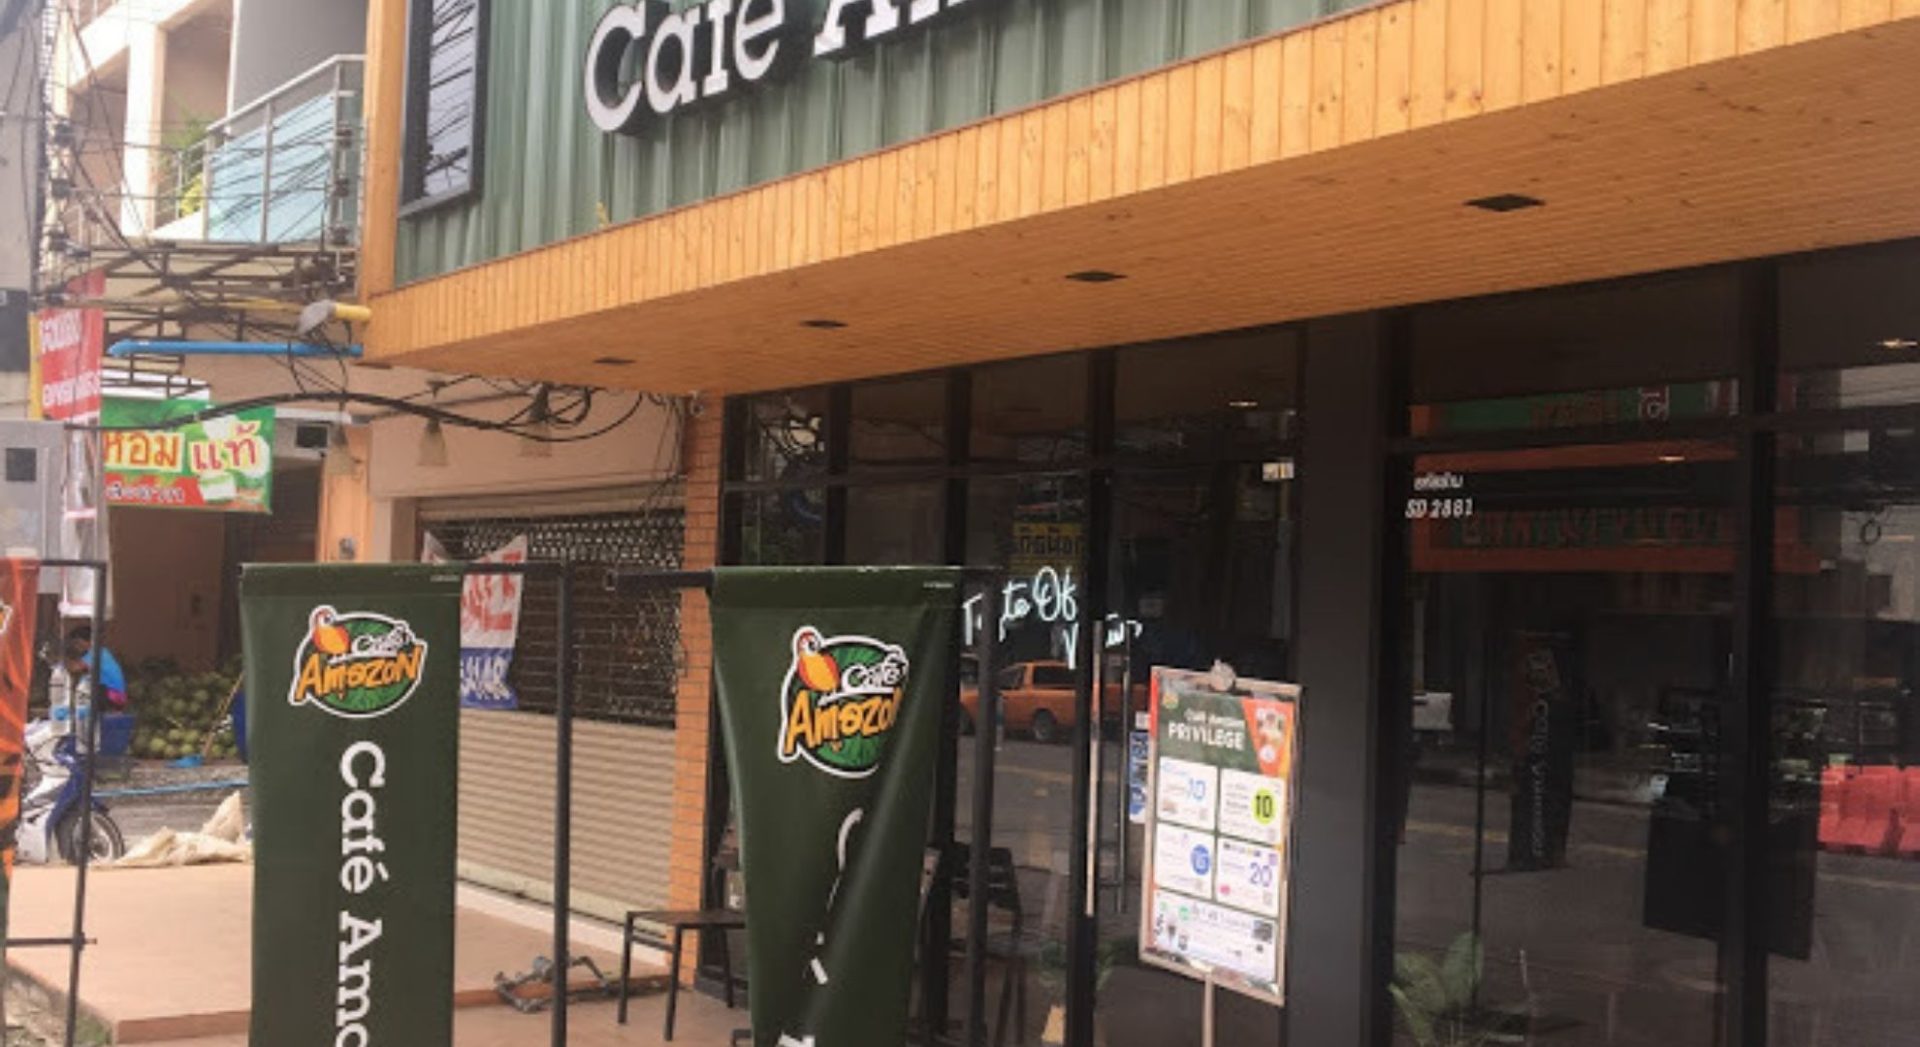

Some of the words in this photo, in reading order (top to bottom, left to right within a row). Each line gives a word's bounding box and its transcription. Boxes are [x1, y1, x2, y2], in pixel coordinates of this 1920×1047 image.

[1168, 721, 1246, 751] PRIVILEGE
[339, 741, 390, 893] Café
[1255, 794, 1274, 818] 10
[1250, 862, 1273, 887] 20
